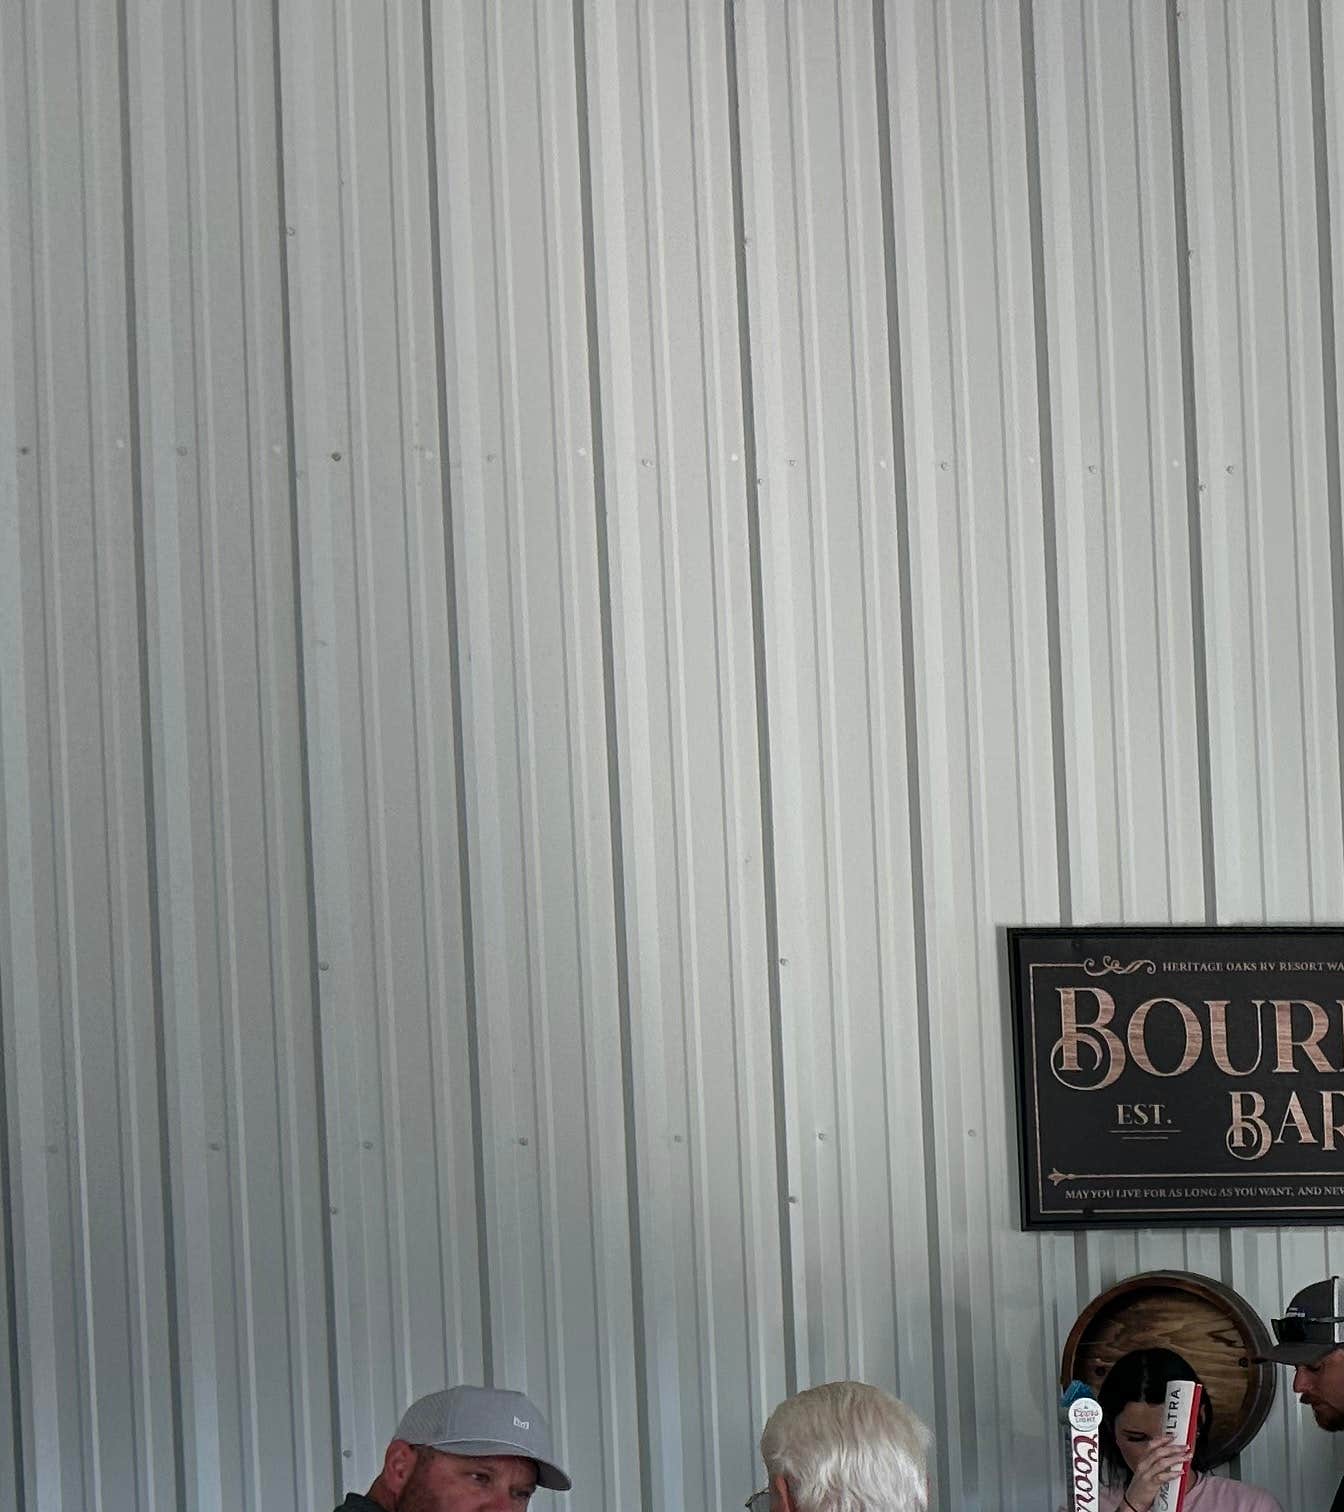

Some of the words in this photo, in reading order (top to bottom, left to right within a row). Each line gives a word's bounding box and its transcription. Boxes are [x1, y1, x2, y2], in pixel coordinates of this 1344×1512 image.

[1162, 961, 1223, 973] HERITAGE
[1226, 961, 1257, 973] OAKS
[1260, 961, 1276, 972] RV
[1279, 961, 1324, 972] RESORT
[1117, 1103, 1173, 1126] EST.
[1065, 1189, 1088, 1200] MAY
[1090, 1189, 1114, 1199] YOU
[1116, 1188, 1141, 1199] LIVE
[1143, 1188, 1166, 1198] FOR
[1168, 1188, 1182, 1198] AS
[1184, 1187, 1217, 1198] LONG
[1219, 1187, 1233, 1197] AS
[1234, 1187, 1259, 1197] YOU
[1298, 1186, 1322, 1196] AND
